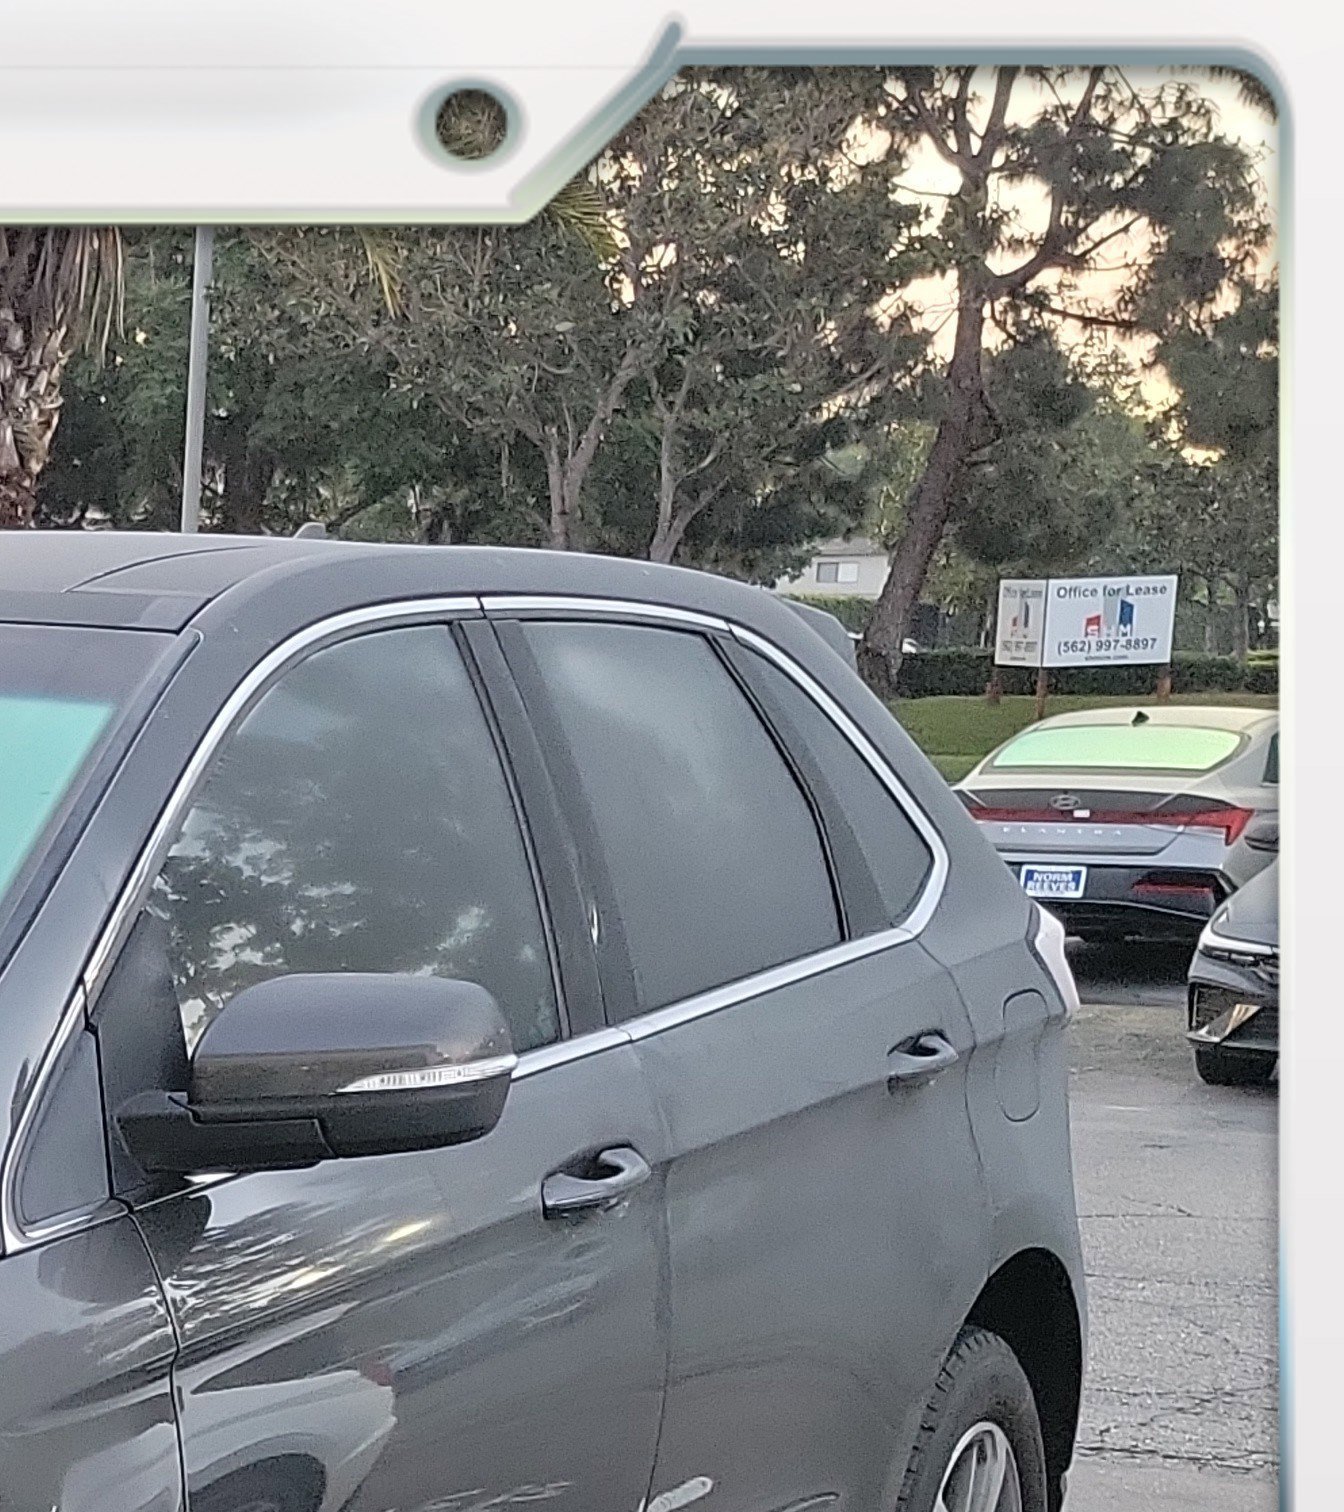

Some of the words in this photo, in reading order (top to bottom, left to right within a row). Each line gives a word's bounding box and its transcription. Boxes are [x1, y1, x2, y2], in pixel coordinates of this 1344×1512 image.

[1056, 586, 1097, 599] Office
[1103, 585, 1121, 597] for
[1126, 583, 1168, 596] Lease
[1057, 640, 1092, 655] (562)
[1095, 638, 1157, 651] 997-8897
[1032, 872, 1073, 882] NORM
[1027, 881, 1076, 892] REEVES
